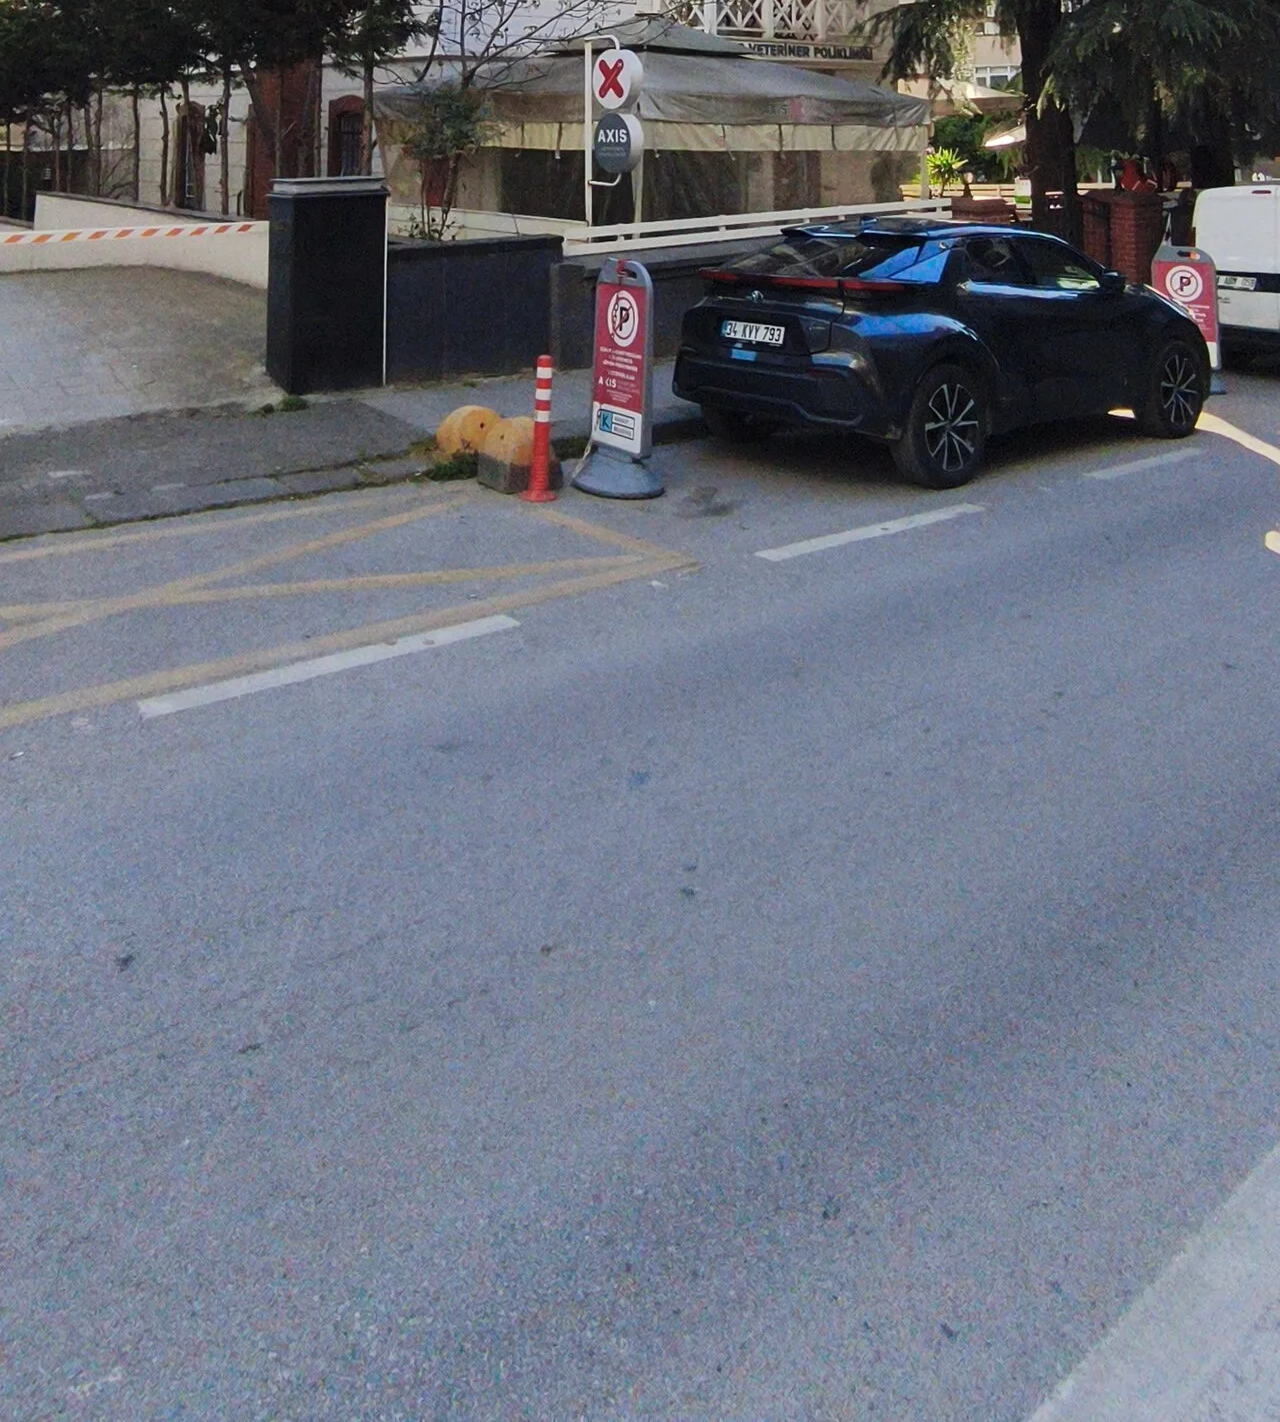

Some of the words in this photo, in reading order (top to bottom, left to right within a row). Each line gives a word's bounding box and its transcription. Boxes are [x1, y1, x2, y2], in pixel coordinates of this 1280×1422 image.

[597, 128, 628, 143] AXIS
[726, 322, 738, 337] 34
[741, 324, 760, 340] KVY
[762, 326, 782, 342] 793
